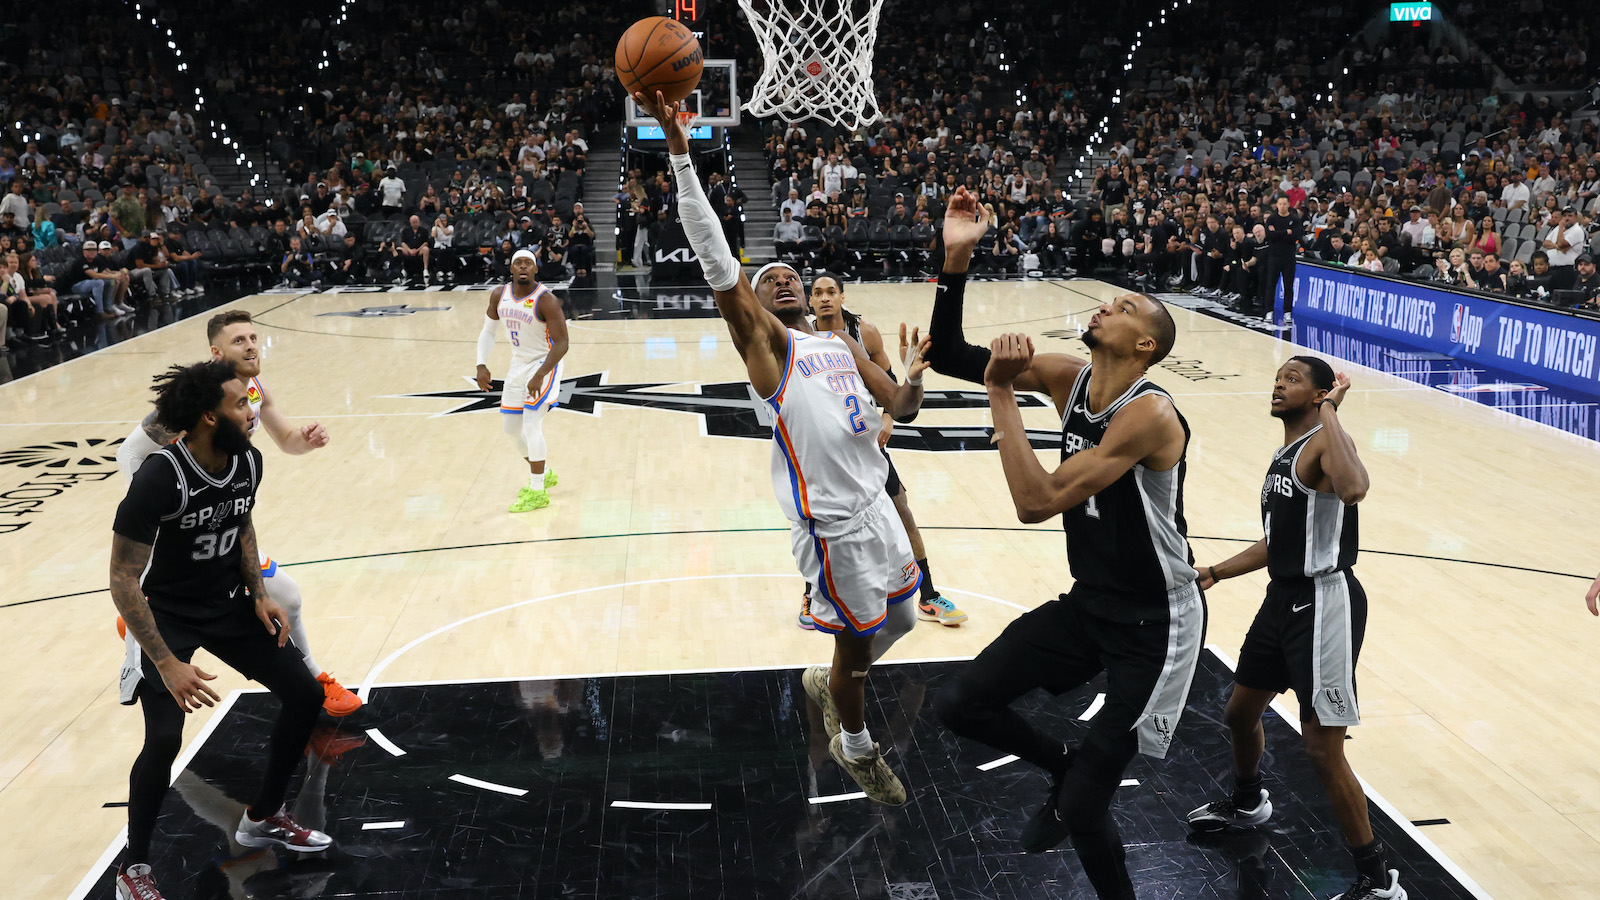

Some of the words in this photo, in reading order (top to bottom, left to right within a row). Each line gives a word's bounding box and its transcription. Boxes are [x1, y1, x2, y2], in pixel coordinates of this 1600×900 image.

[675, 0, 697, 21] 14
[1307, 277, 1324, 310] TAP
[1324, 279, 1336, 313] TO
[1335, 282, 1366, 321] WATCH
[1366, 289, 1386, 326] THE
[1385, 293, 1436, 338] PLAYOFFS
[506, 319, 521, 330] CITY
[511, 330, 520, 347] 5
[1459, 306, 1483, 355] App
[1497, 316, 1522, 359] TAP
[1524, 322, 1542, 366] TO
[1544, 326, 1597, 379] WATCH
[795, 352, 858, 378] OKLAHO
[826, 372, 859, 394] CITY
[844, 393, 870, 436] 2
[191, 526, 239, 560] 30
